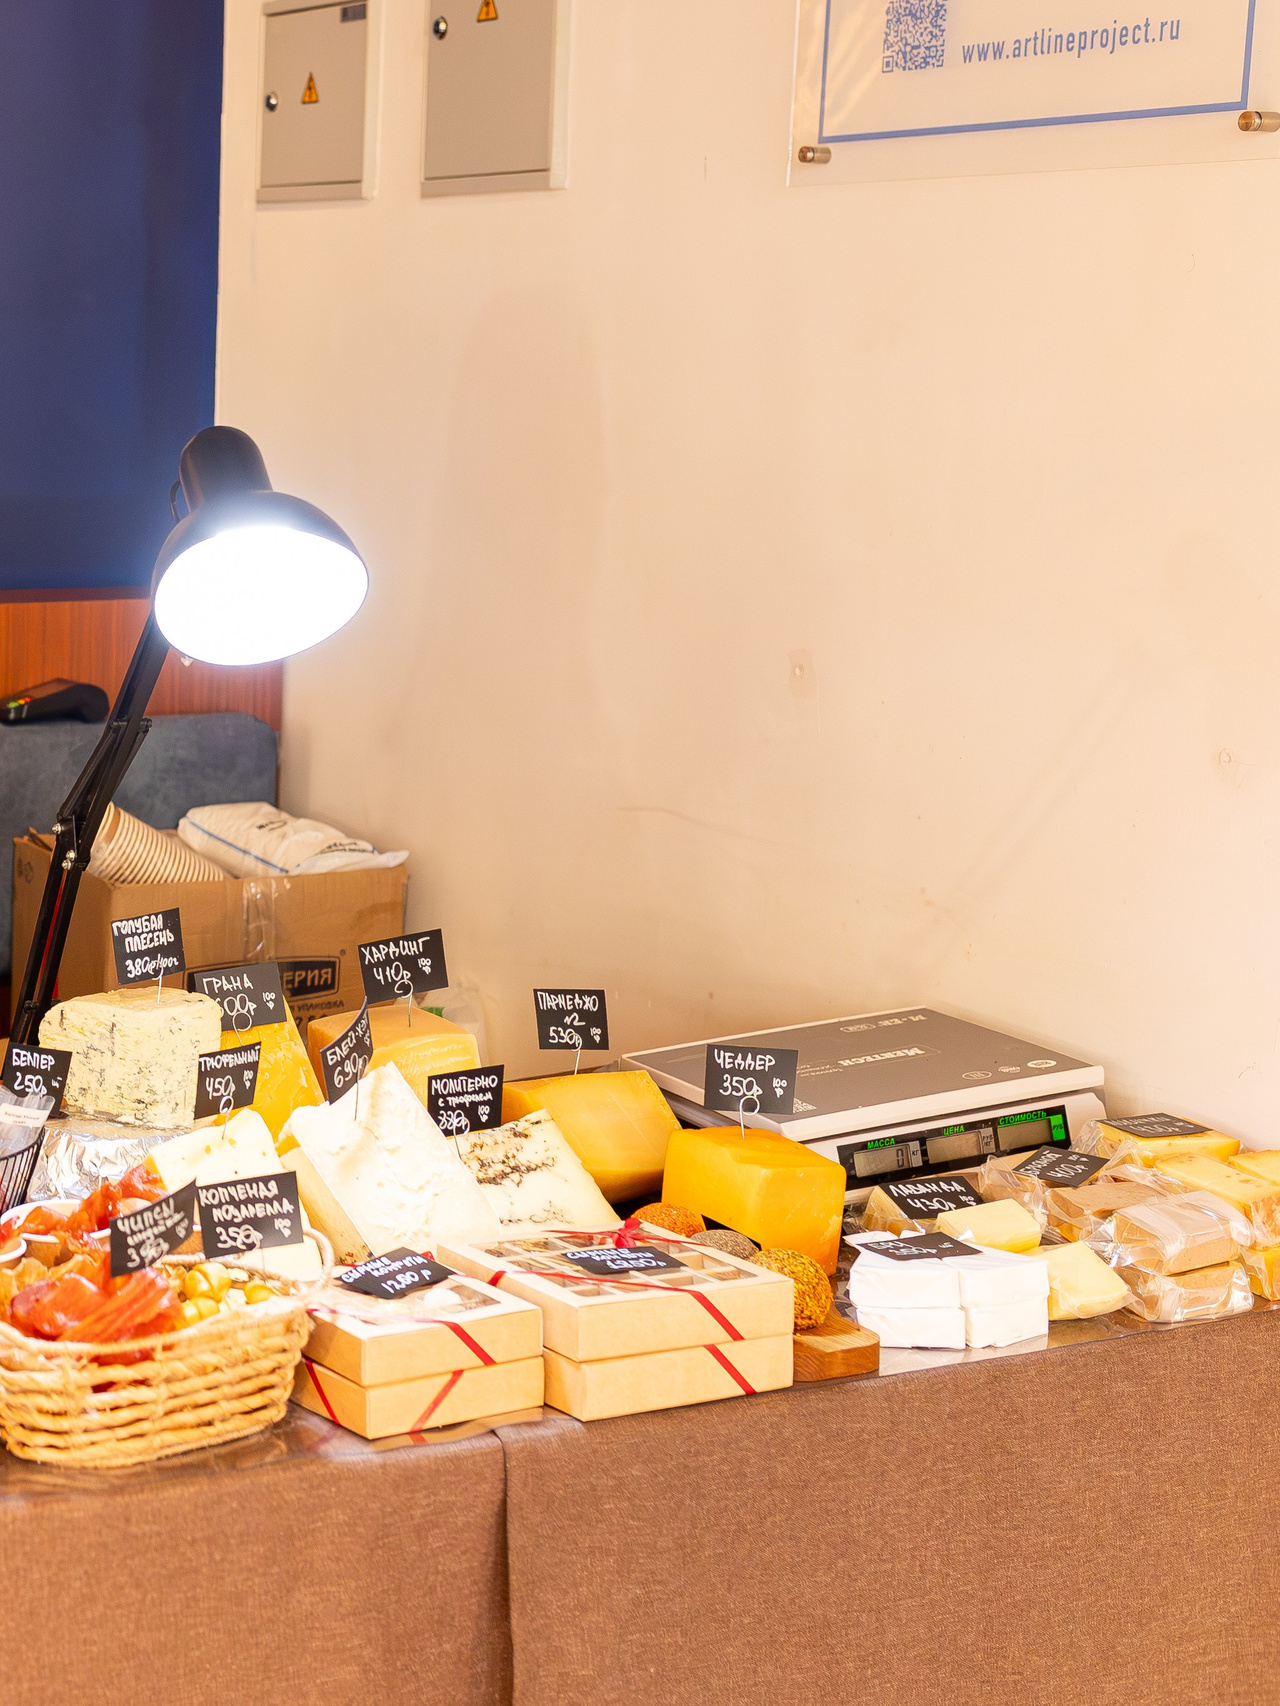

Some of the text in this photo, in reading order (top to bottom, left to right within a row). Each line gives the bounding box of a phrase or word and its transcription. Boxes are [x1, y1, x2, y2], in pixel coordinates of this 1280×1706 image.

[962, 17, 1181, 64] www.artlineproject.ru
[112, 913, 163, 937] ГОЛУБАЯ
[125, 929, 175, 953] ПЛЕСЕНЬ
[361, 936, 430, 965] ХАРДИНГ
[418, 957, 431, 968] 100
[203, 973, 254, 994] ГРАНА
[262, 992, 276, 1002] 100
[537, 991, 598, 1012] ПАРМЕДЖО
[590, 1027, 601, 1036] 100
[12, 1048, 55, 1072] БЕЛПЕР
[715, 1048, 776, 1072] ЧЕДДЕР
[432, 1075, 498, 1095] МОЛИТЕРНО
[773, 1077, 787, 1088] 100
[478, 1105, 490, 1115] 100
[999, 1110, 1047, 1125] СТОИМОСТЬ
[943, 1125, 965, 1136] ЦЕНА
[867, 1138, 896, 1150] МАССА
[198, 1180, 279, 1207] КОПЧЕНАЯ
[117, 1197, 174, 1235] ЧИПСЫ
